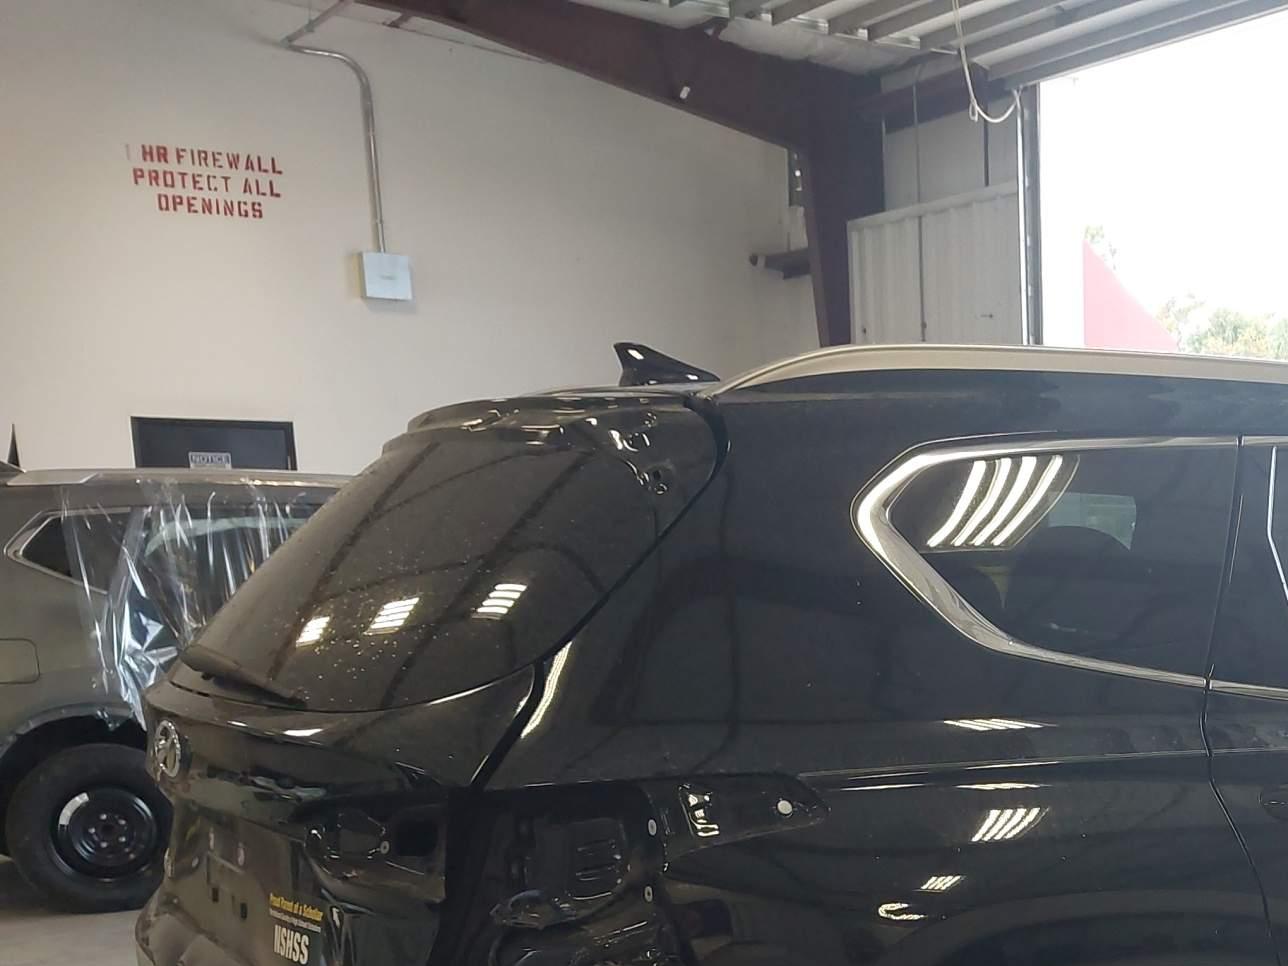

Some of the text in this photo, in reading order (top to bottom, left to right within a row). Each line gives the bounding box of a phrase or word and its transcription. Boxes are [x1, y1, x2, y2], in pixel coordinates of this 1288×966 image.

[141, 144, 168, 164] HR
[176, 148, 283, 175] FIREWALL
[132, 168, 281, 198] PROTECT ALL
[157, 194, 263, 219] OPENINGS
[191, 455, 229, 464] NOTICE
[274, 924, 309, 965] NSHSS
